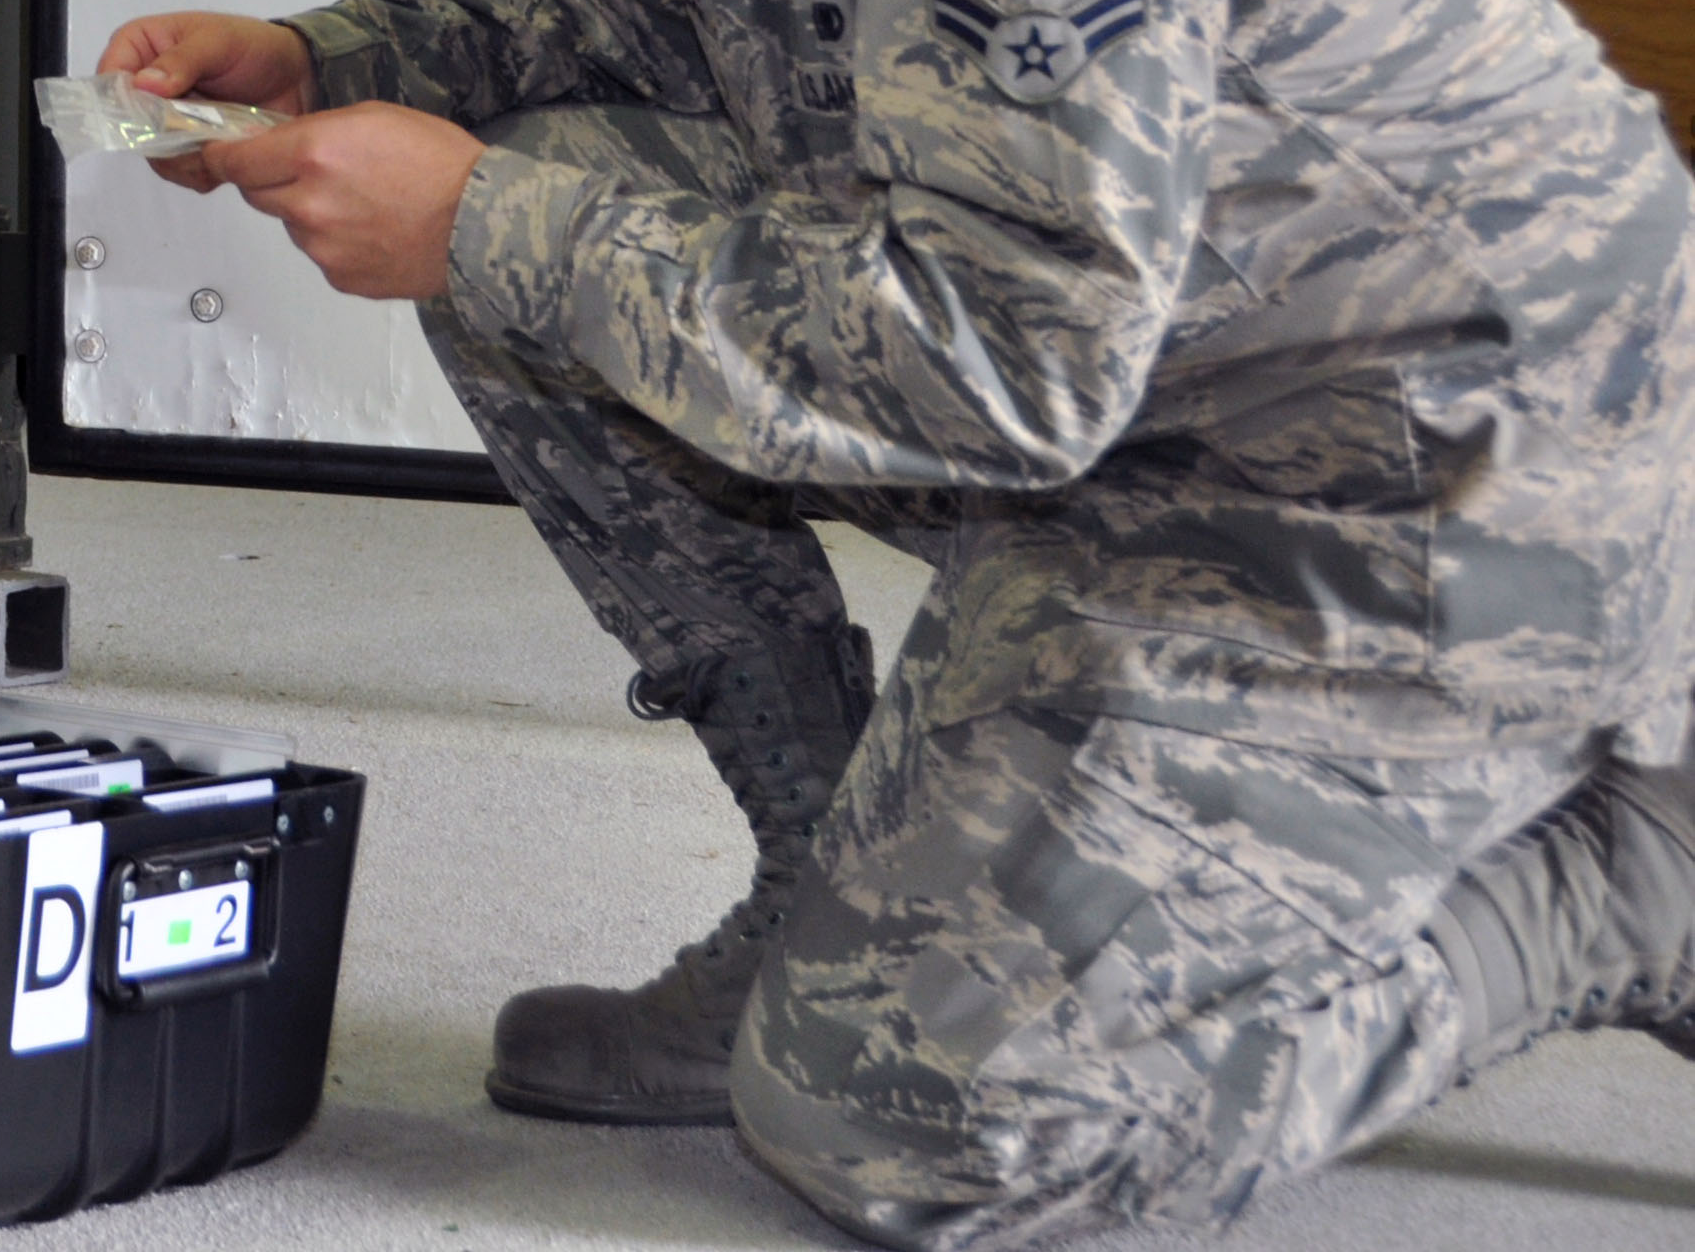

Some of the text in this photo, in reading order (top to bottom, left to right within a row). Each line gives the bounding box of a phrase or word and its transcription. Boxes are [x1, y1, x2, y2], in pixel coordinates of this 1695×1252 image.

[23, 884, 86, 993] D
[121, 893, 238, 963] 1 2
